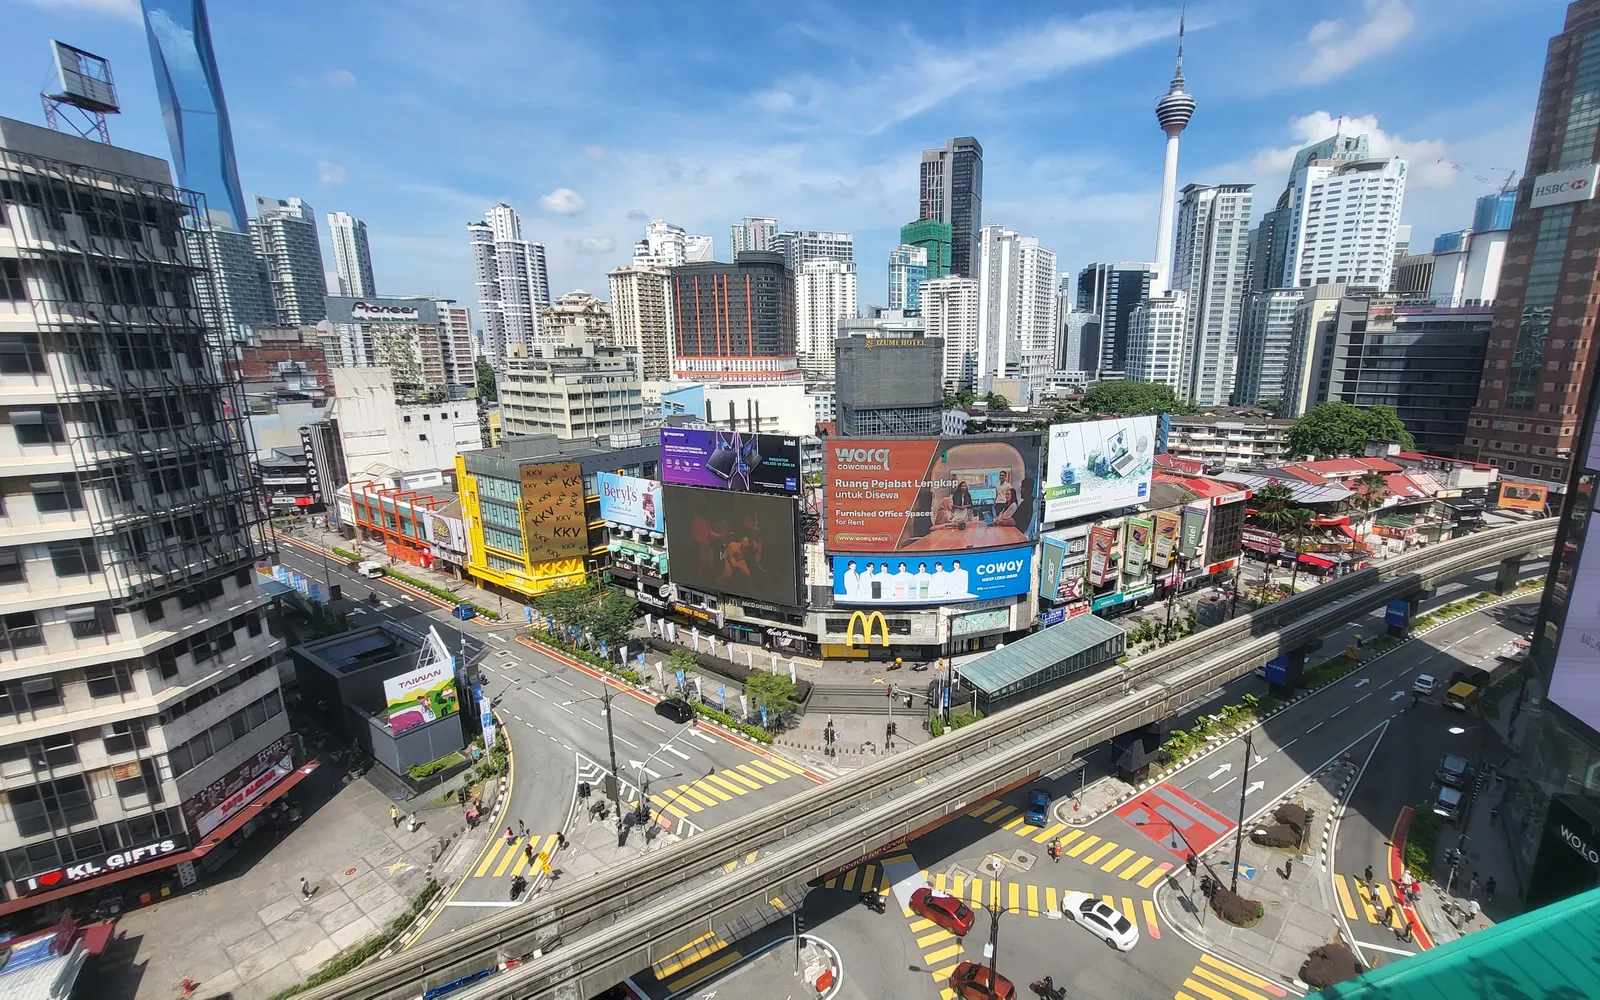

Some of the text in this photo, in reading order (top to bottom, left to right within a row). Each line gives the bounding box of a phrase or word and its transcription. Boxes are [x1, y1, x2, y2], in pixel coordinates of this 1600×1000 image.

[1536, 182, 1569, 197] HSBC
[352, 301, 419, 314] Pioneer
[876, 339, 926, 347] IZUMI HOTEL
[1054, 430, 1071, 438] acer
[302, 436, 320, 492] KARAOKE
[834, 447, 890, 471] worq
[526, 469, 543, 477] KKV
[837, 463, 882, 471] COWORKING
[544, 472, 558, 486] KKV
[835, 478, 959, 489] Ruang Pejabat Lengkap
[538, 491, 552, 503] KKV
[555, 491, 567, 507] KKV
[569, 491, 579, 508] KKV
[602, 481, 638, 505] Beryl's
[835, 490, 899, 499] untuk Disewa
[1051, 488, 1067, 498] Aspire
[531, 506, 554, 527] KKV
[555, 514, 572, 522] KKV
[835, 509, 934, 519] Furnished Office Spaces
[533, 531, 550, 543] KKV
[553, 526, 581, 538] KKV
[1188, 525, 1197, 545] intel
[539, 558, 577, 576] KKV
[976, 559, 1024, 576] coway
[741, 600, 778, 612] McDonald's
[398, 669, 442, 688] TAIWAN
[1560, 824, 1599, 863] WOLO
[66, 861, 101, 880] KL
[106, 840, 175, 867] GIFTS
[838, 836, 907, 873] Reach for Great
